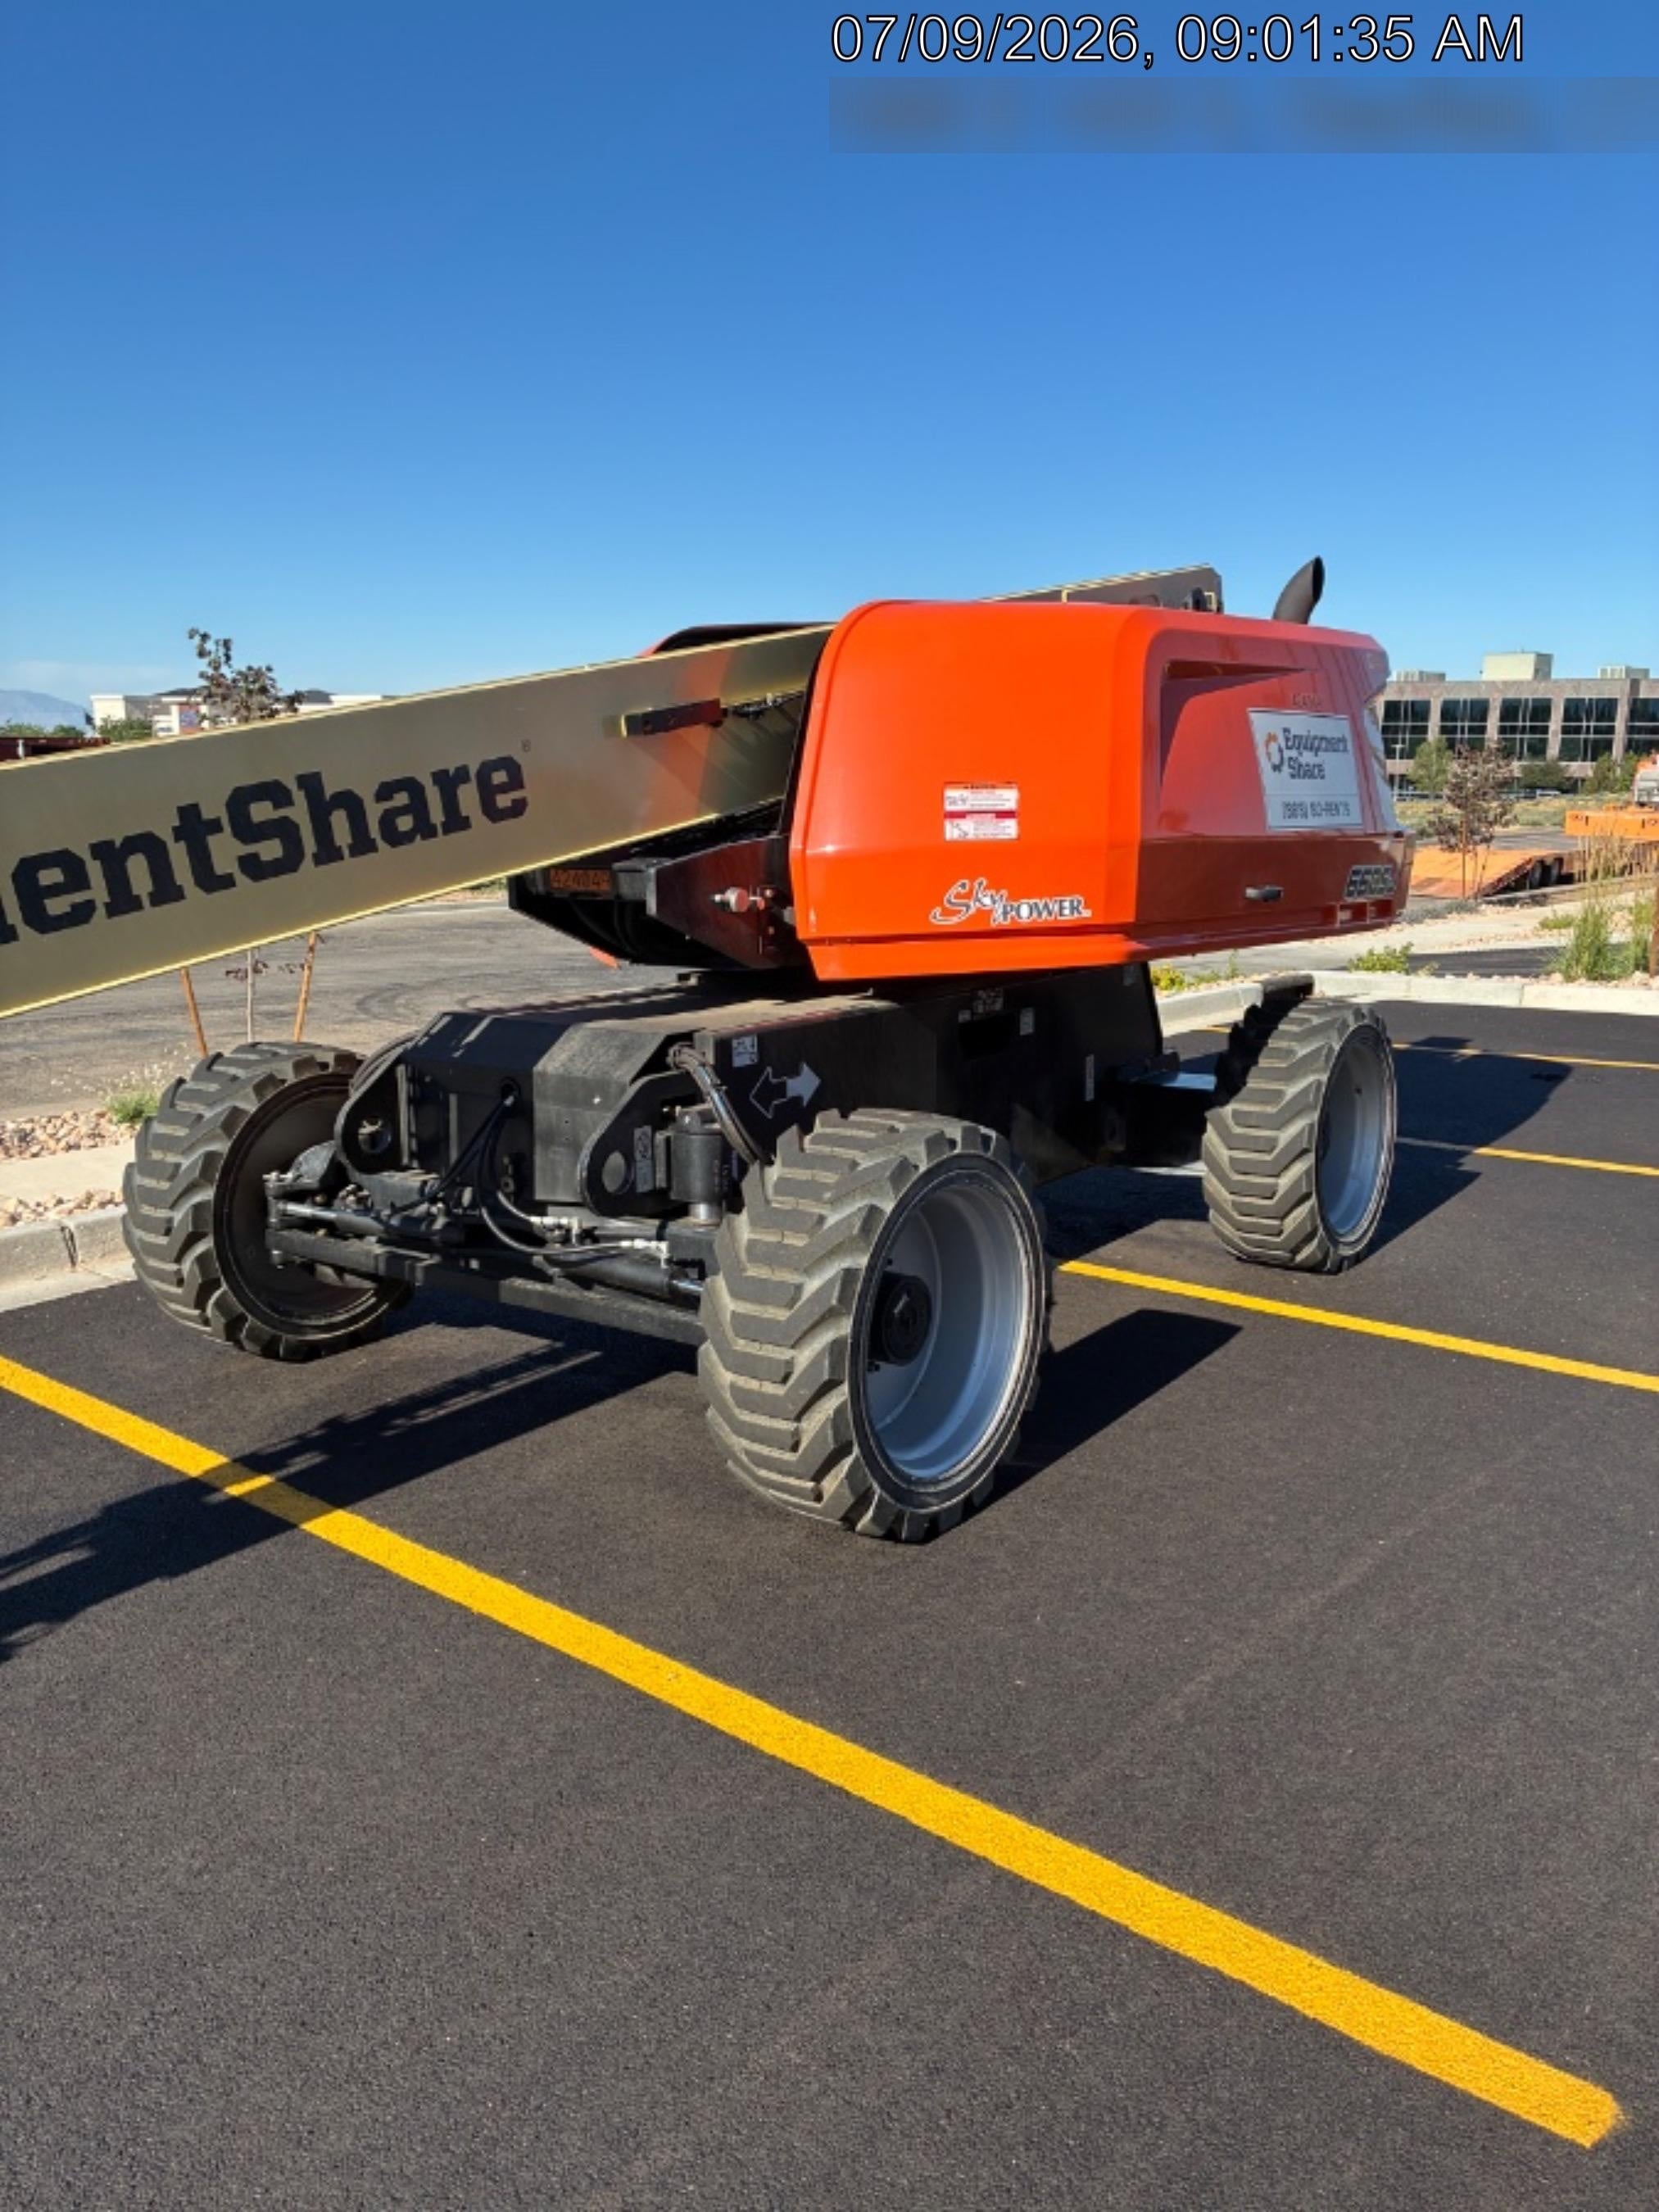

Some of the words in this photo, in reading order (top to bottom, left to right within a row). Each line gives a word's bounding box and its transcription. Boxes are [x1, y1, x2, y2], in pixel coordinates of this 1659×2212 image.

[1282, 728, 1348, 757] Equipment
[1287, 756, 1326, 780] Share
[0, 755, 528, 945] entShare
